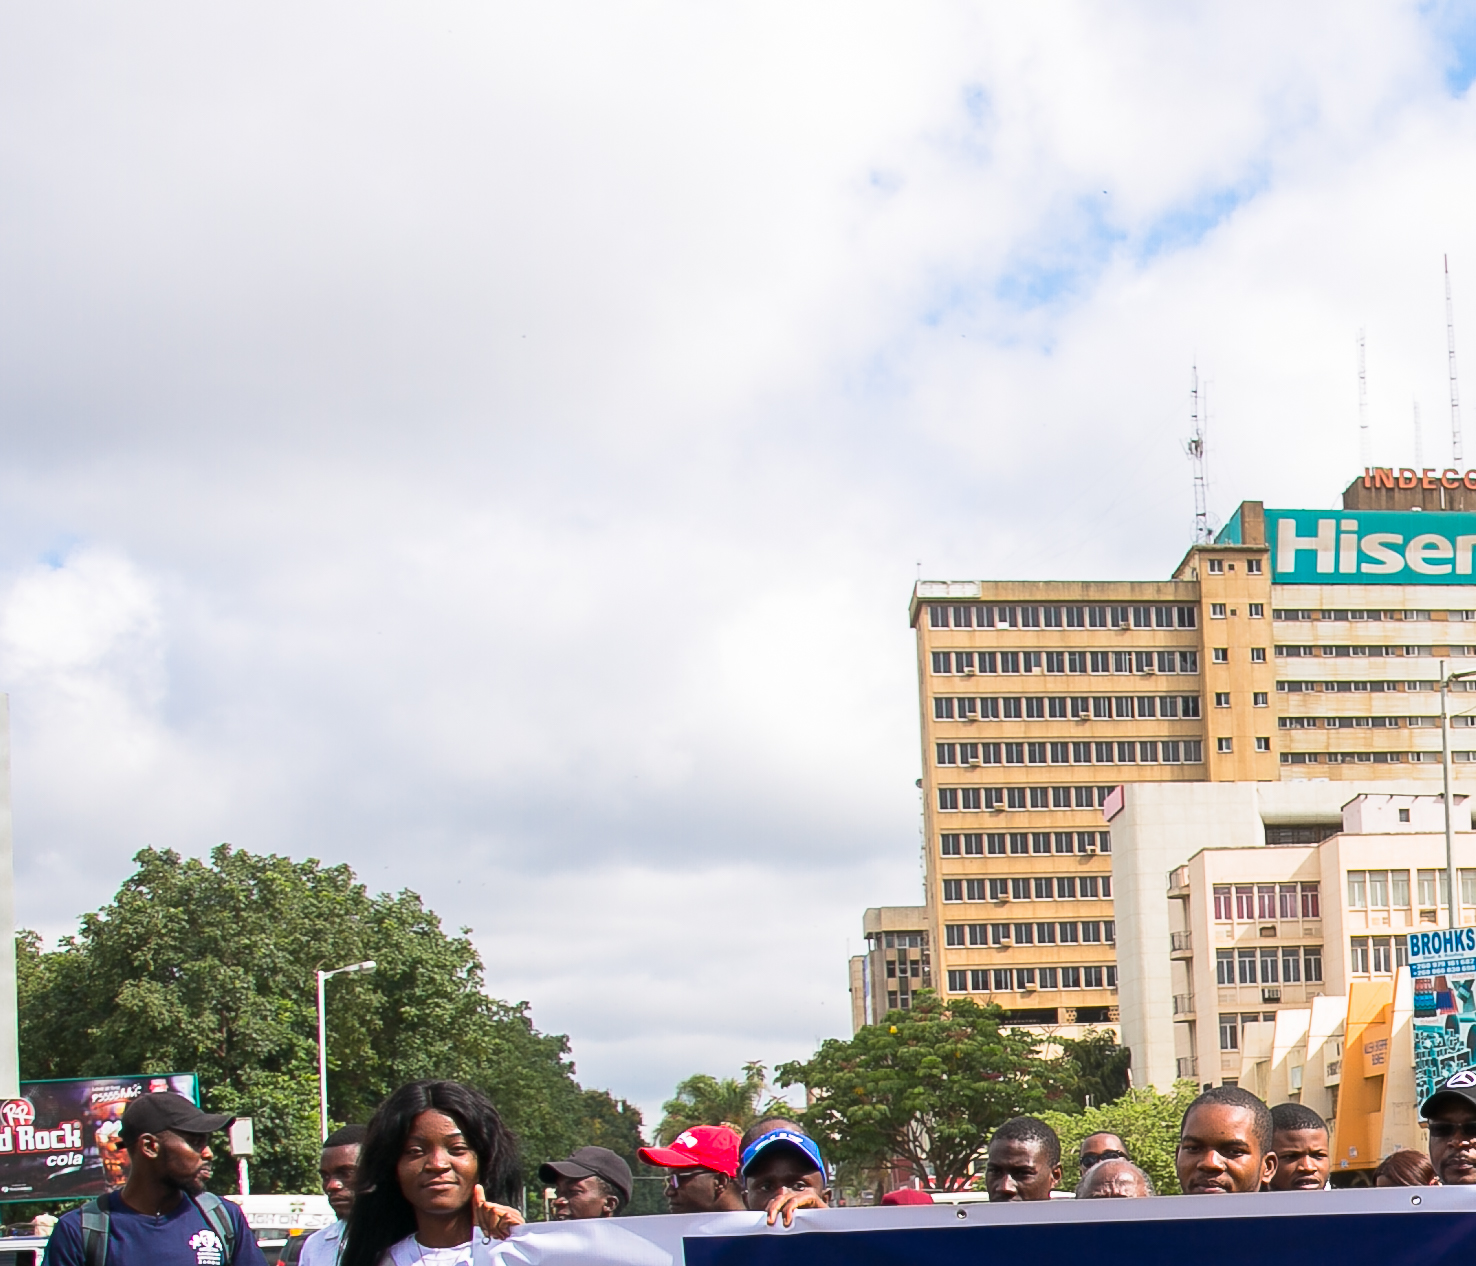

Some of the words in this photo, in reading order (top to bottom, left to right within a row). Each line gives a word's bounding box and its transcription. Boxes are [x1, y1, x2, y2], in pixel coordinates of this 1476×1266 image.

[1409, 928, 1476, 957] BROHKS
[16, 1123, 82, 1151] Rock
[46, 1151, 84, 1167] cola
